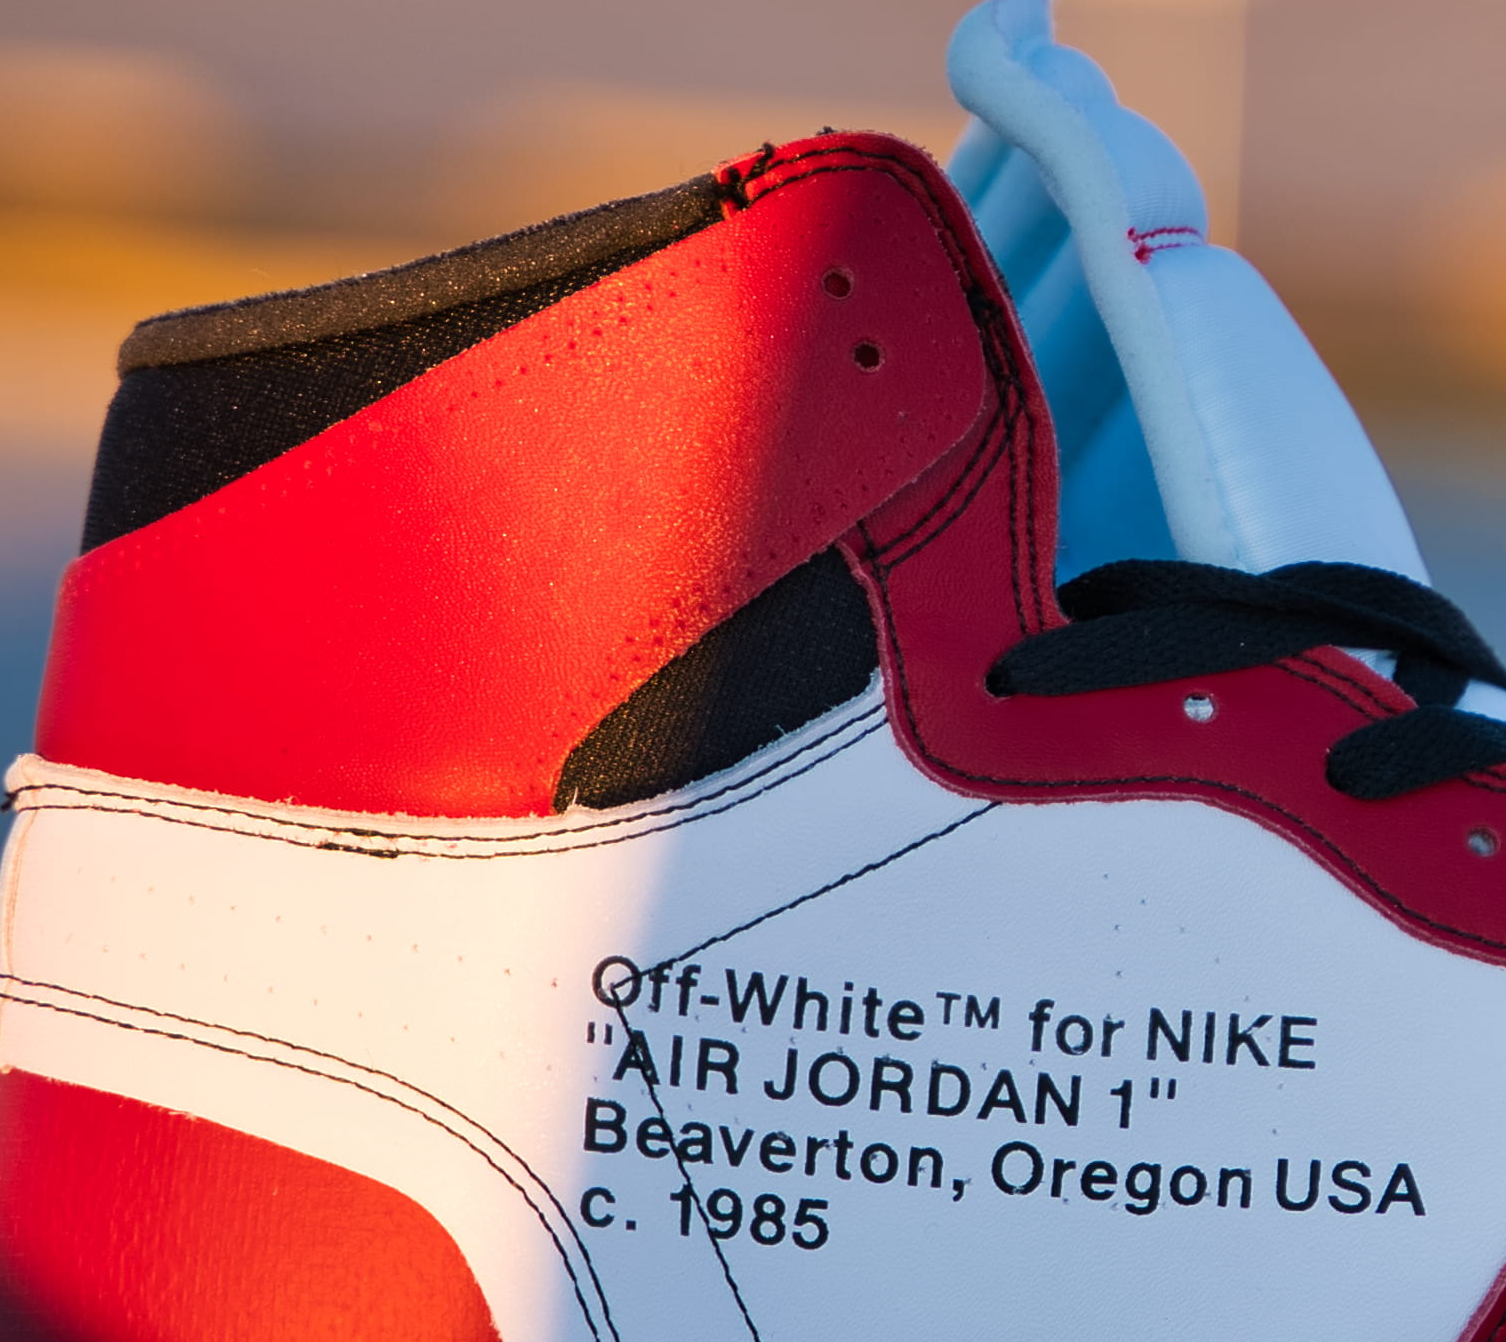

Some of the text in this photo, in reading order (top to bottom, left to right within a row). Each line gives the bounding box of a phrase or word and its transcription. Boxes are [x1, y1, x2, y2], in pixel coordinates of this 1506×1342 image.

[584, 1022, 1178, 1130] "AIR JORDAN 1"
[1028, 999, 1126, 1057] for
[1146, 1007, 1318, 1070] NIKE
[582, 1096, 1427, 1216] Beaverton, Oregon USA
[579, 1185, 831, 1251] c. 1985
